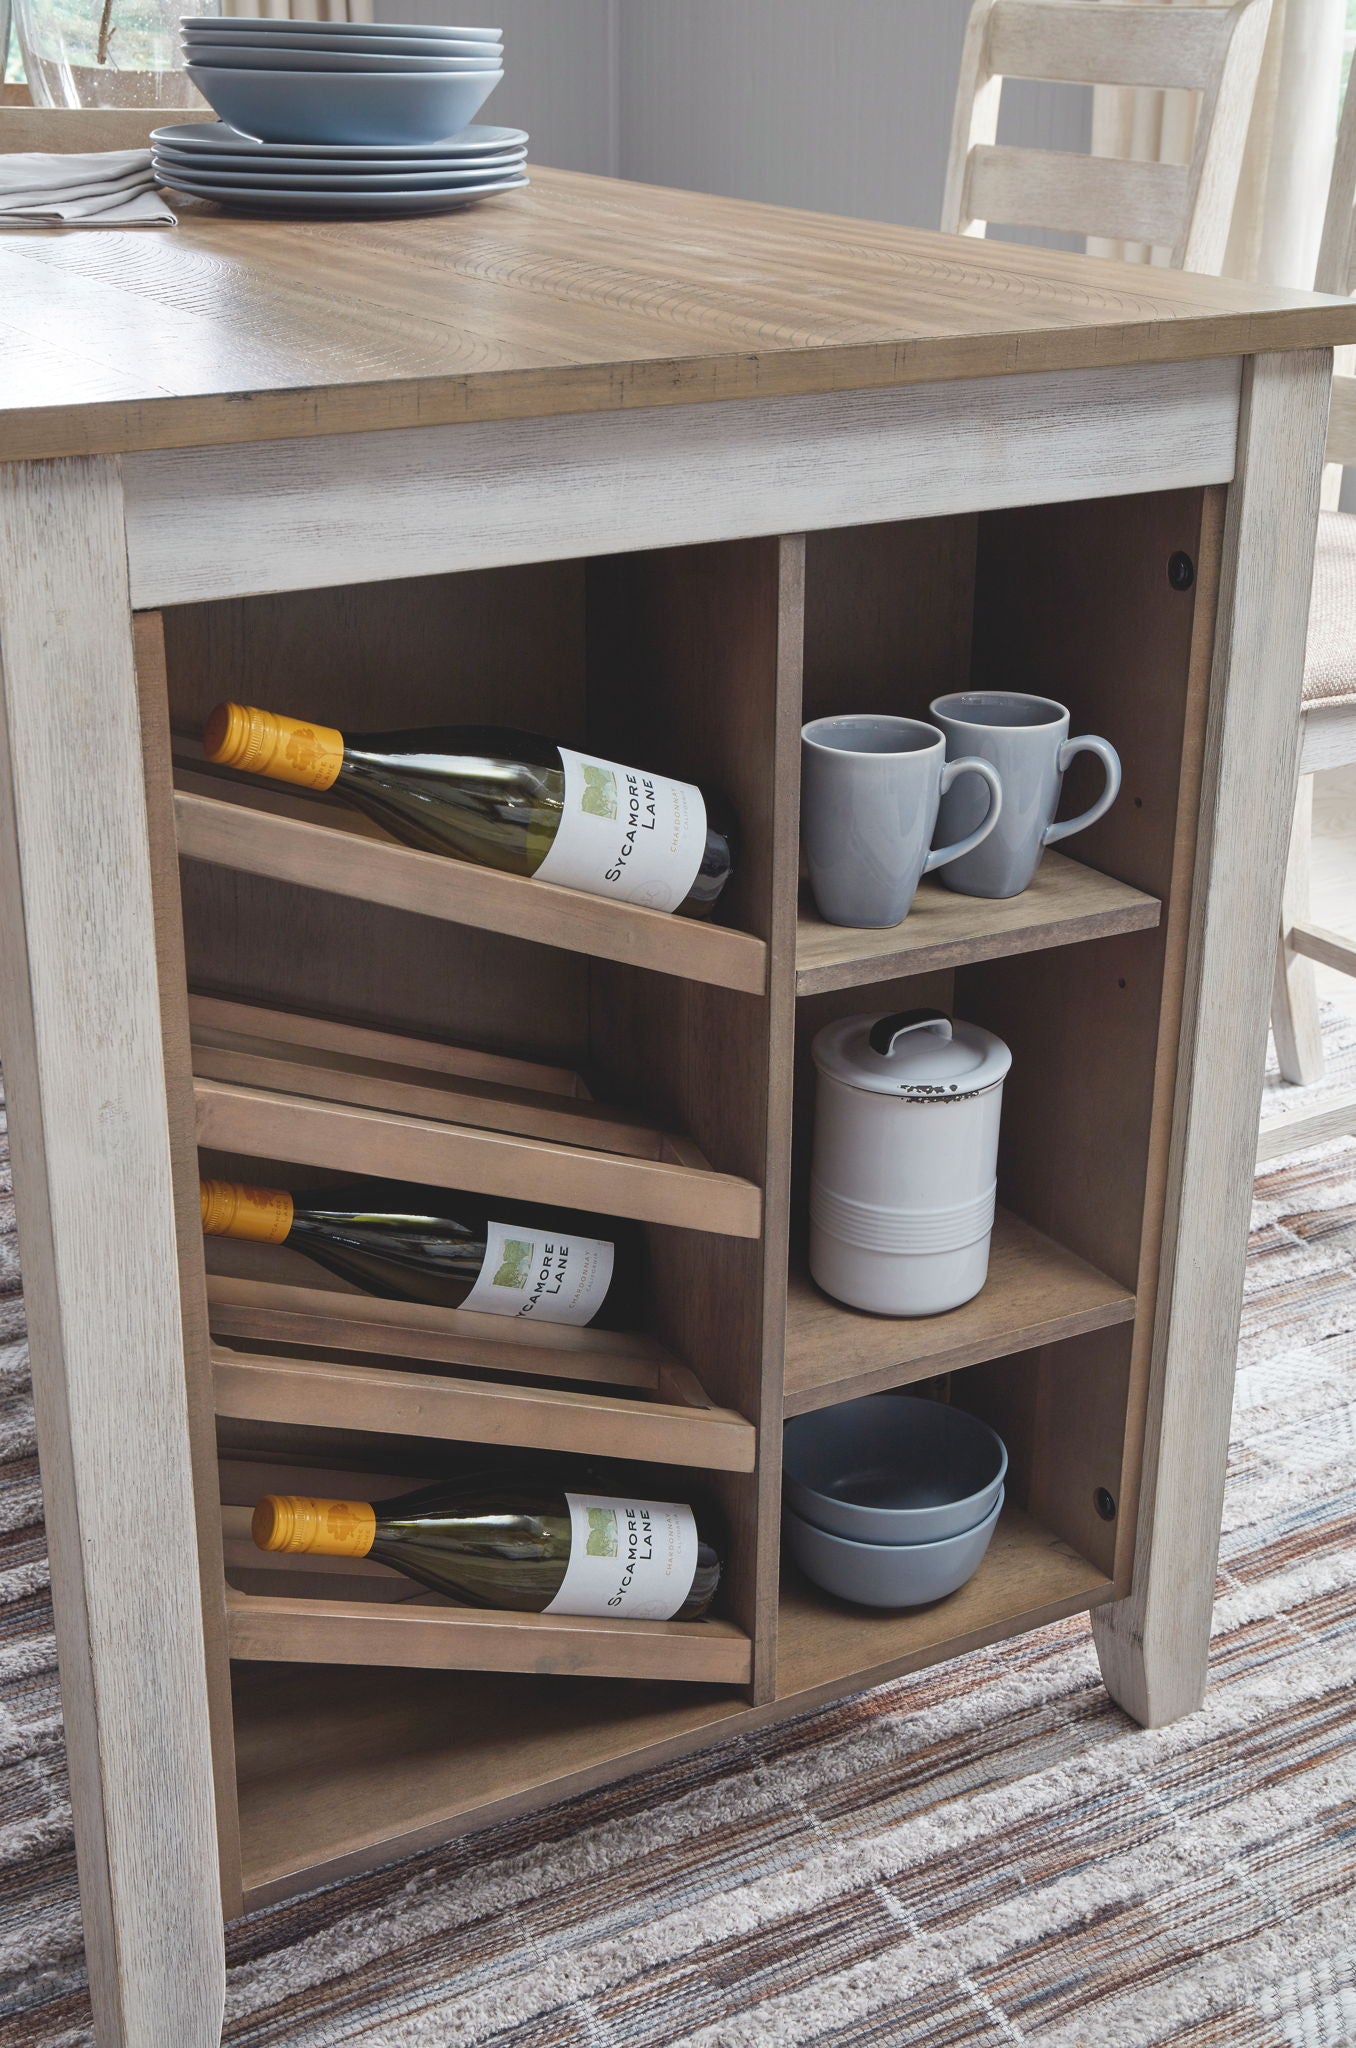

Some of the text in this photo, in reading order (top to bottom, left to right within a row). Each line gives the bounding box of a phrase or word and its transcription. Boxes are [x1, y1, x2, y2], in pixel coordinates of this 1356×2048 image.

[605, 774, 639, 882] SYCAMORE
[642, 778, 656, 830] LANE
[516, 1243, 554, 1317] YCAMORE
[546, 1246, 569, 1294] LANE
[568, 1251, 590, 1309] CHARDONNAY
[607, 1508, 638, 1606] SYCAMORE
[640, 1510, 652, 1559] LANE
[665, 1513, 674, 1576] CHARDONNAY
